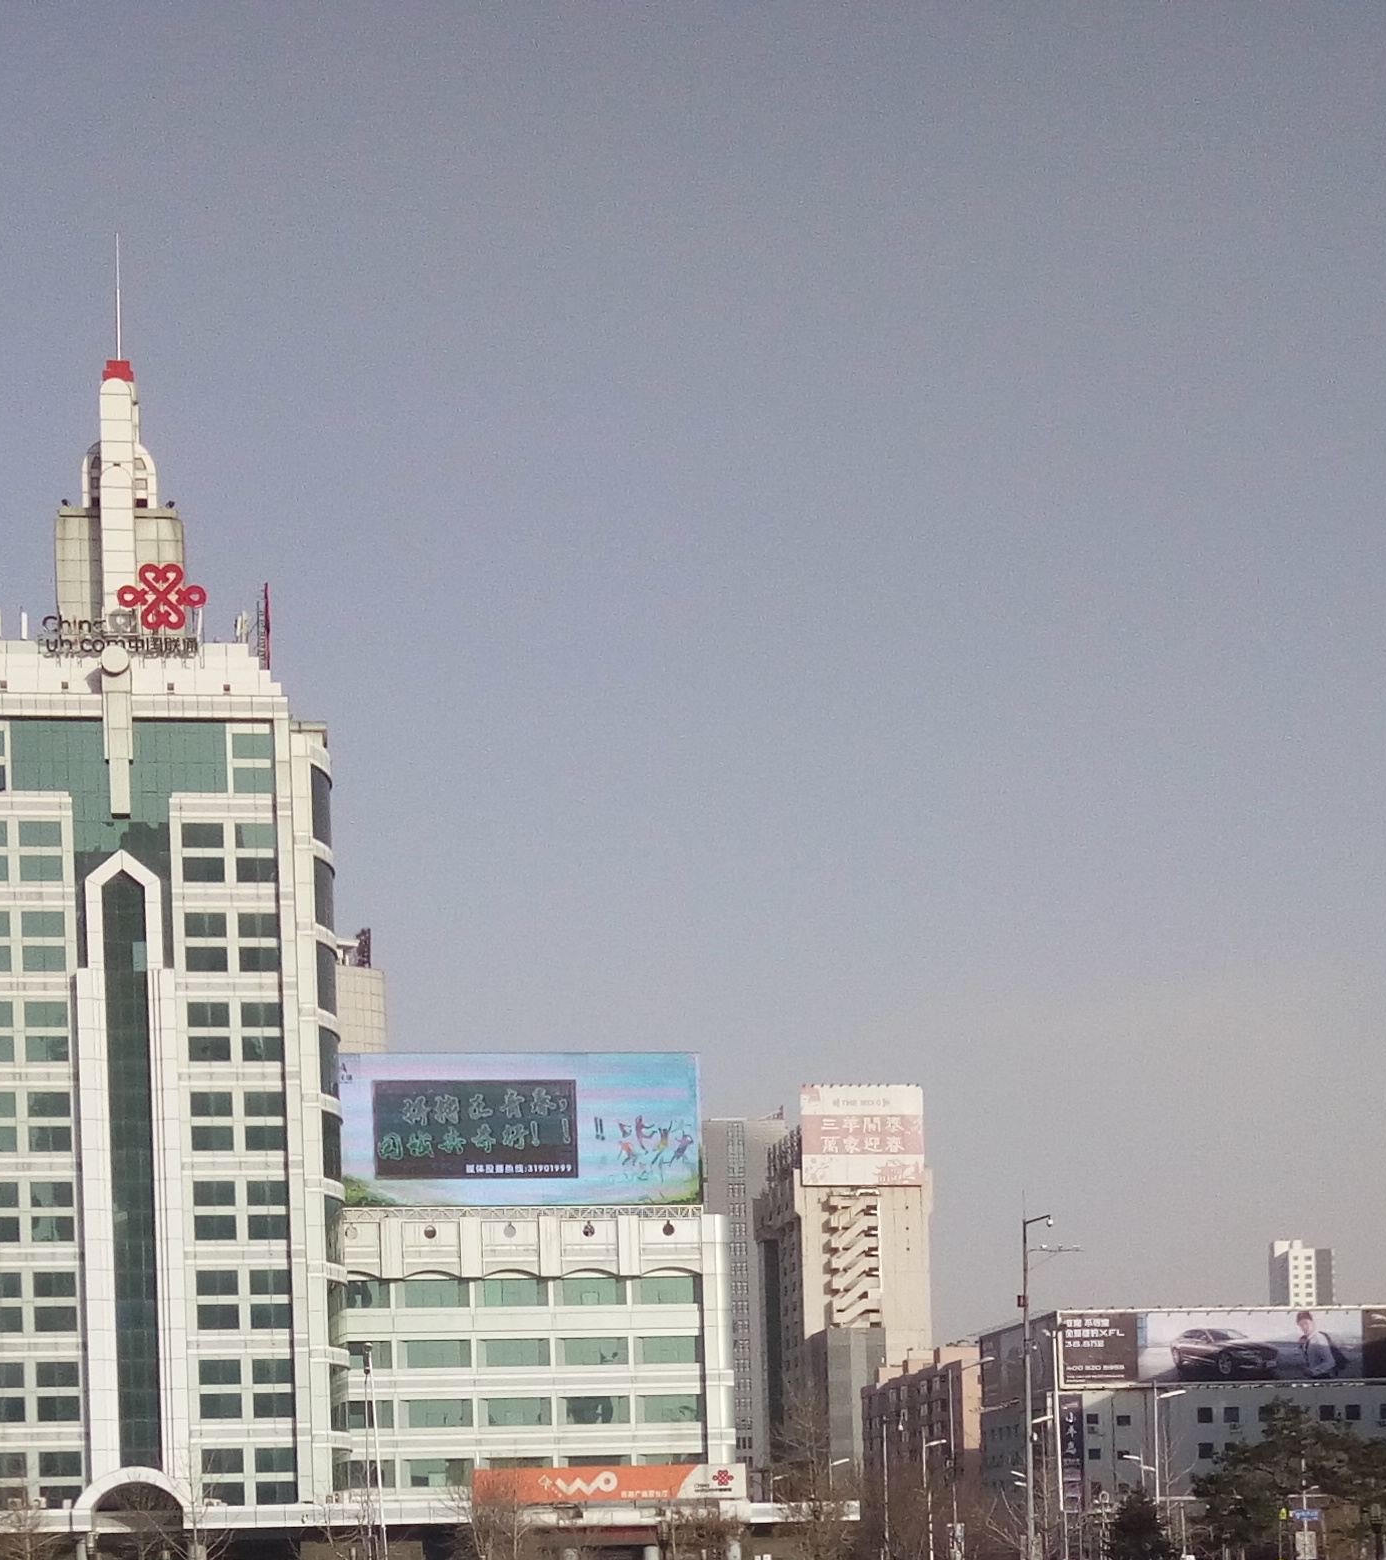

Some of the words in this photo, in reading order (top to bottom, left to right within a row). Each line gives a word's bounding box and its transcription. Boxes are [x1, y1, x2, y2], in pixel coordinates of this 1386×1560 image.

[42, 615, 105, 633] China
[820, 1116, 905, 1133] 三羊開泰
[820, 1135, 905, 1154] 萬家迎春
